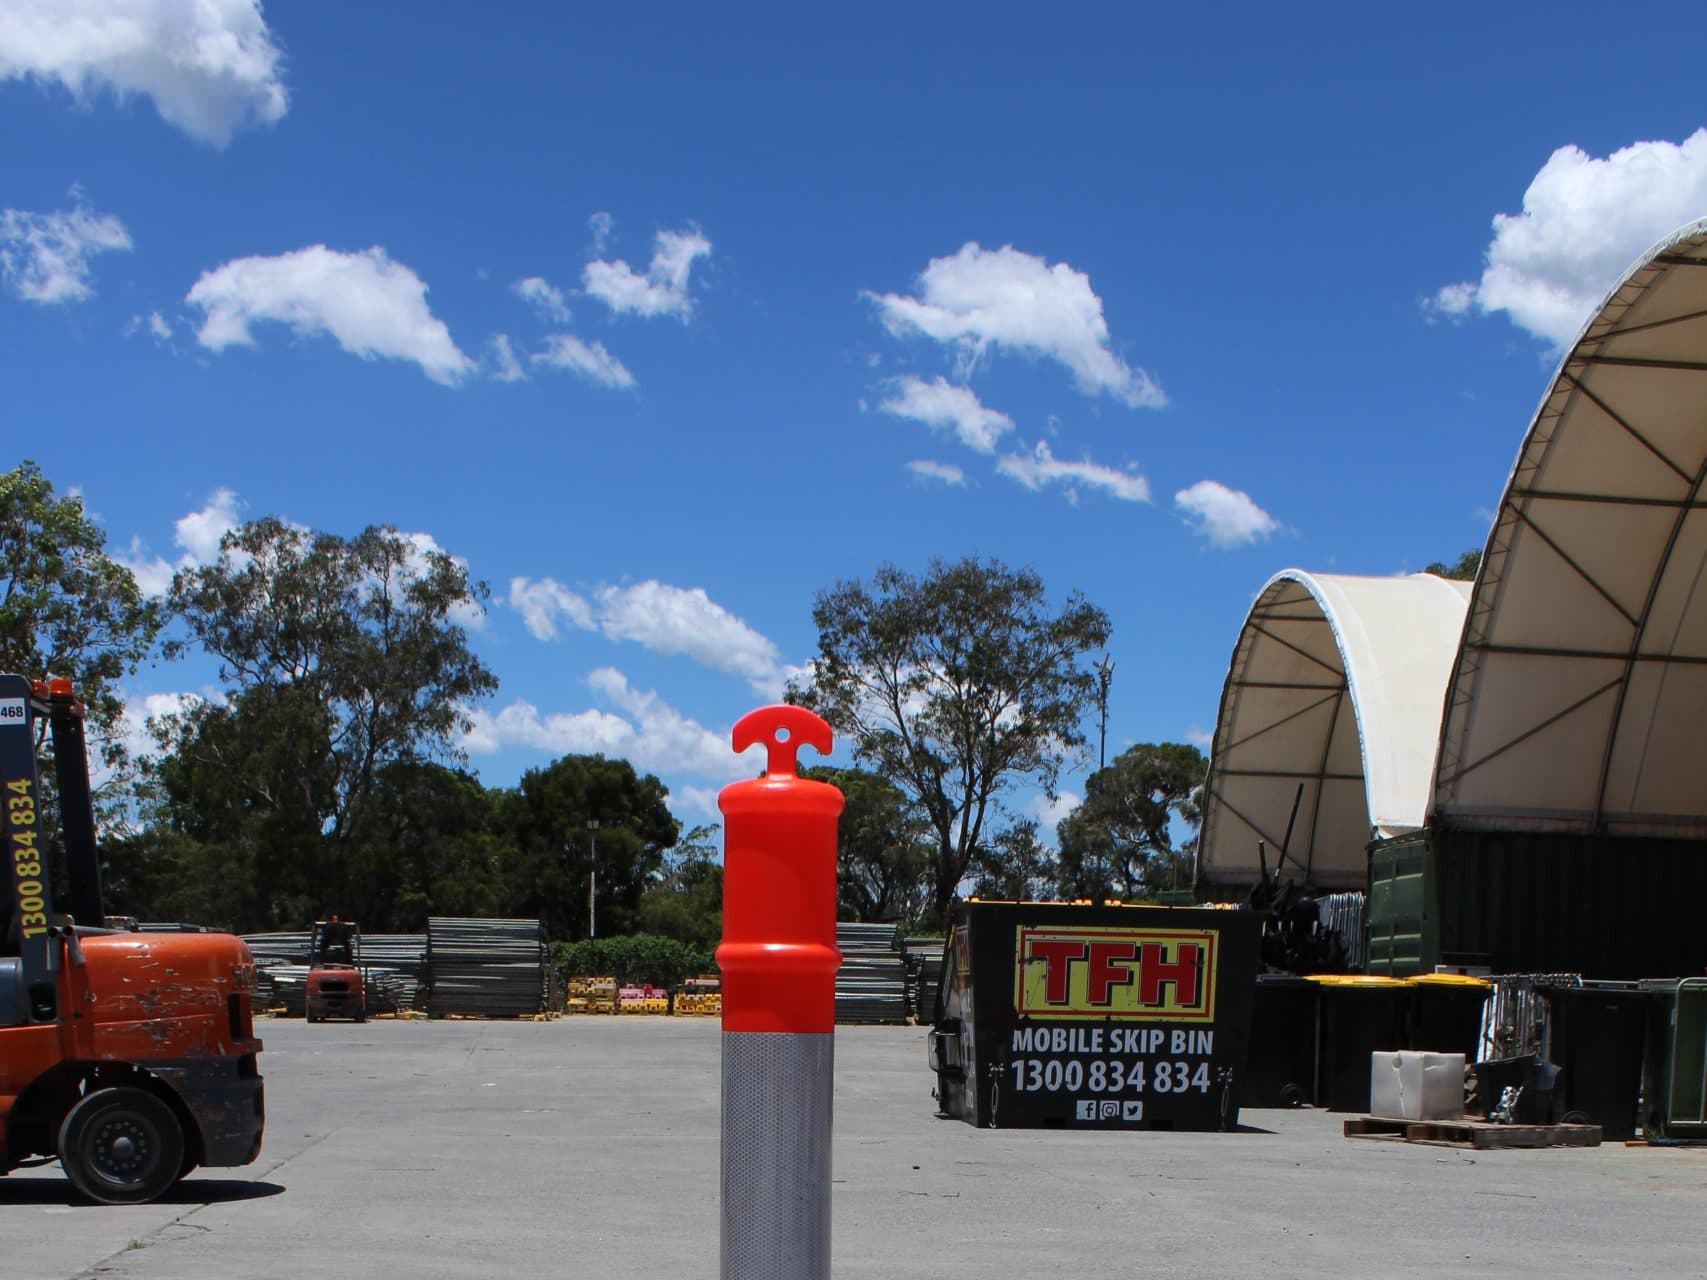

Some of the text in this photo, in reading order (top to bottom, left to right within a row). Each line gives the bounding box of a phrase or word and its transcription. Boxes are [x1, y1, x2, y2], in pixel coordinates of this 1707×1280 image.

[1, 706, 24, 718] 468
[8, 778, 47, 939] 1300 834 834
[1030, 940, 1201, 1007] TFH
[1012, 1027, 1214, 1055] MOBILE SKIP BIN
[1011, 1059, 1084, 1092] 1300
[1088, 1060, 1146, 1093] 834
[1153, 1061, 1211, 1094] 834
